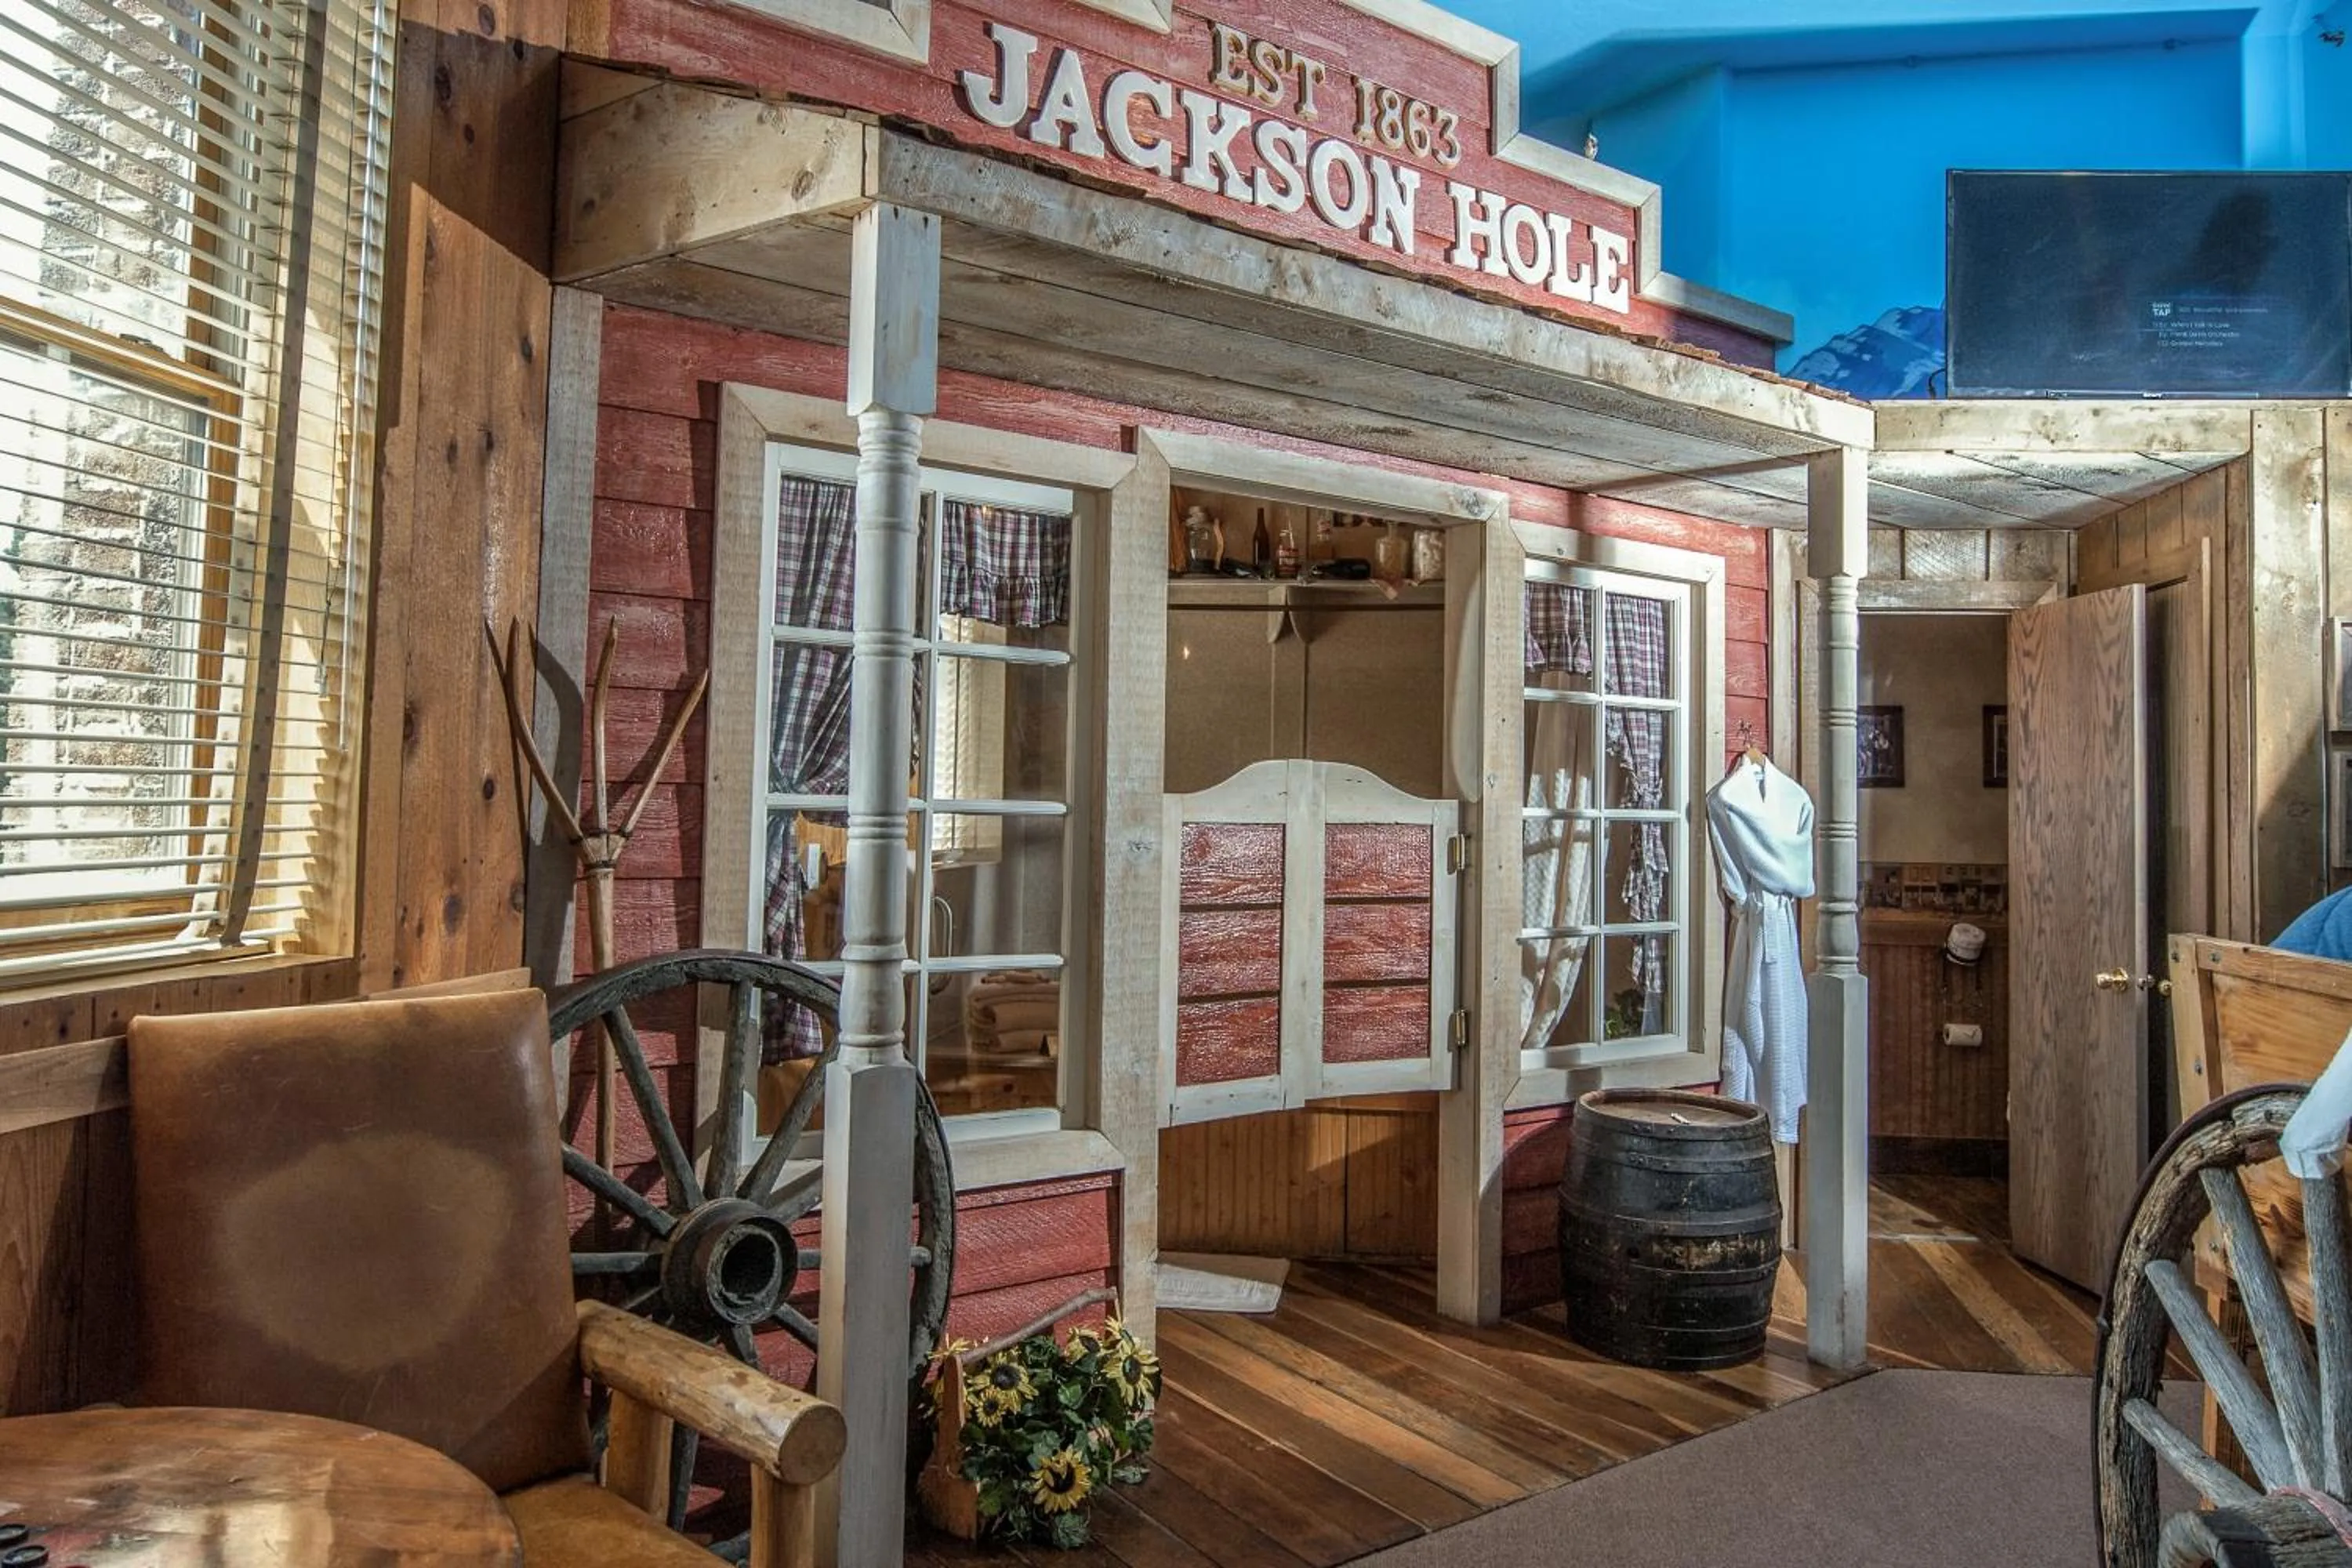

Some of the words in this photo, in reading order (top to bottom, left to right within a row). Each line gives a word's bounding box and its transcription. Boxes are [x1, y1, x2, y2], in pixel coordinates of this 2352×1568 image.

[962, 21, 1421, 254] JACKSON
[1448, 181, 1630, 314] HOLE
[1208, 21, 1326, 122] EST
[1352, 74, 1462, 169] 1863
